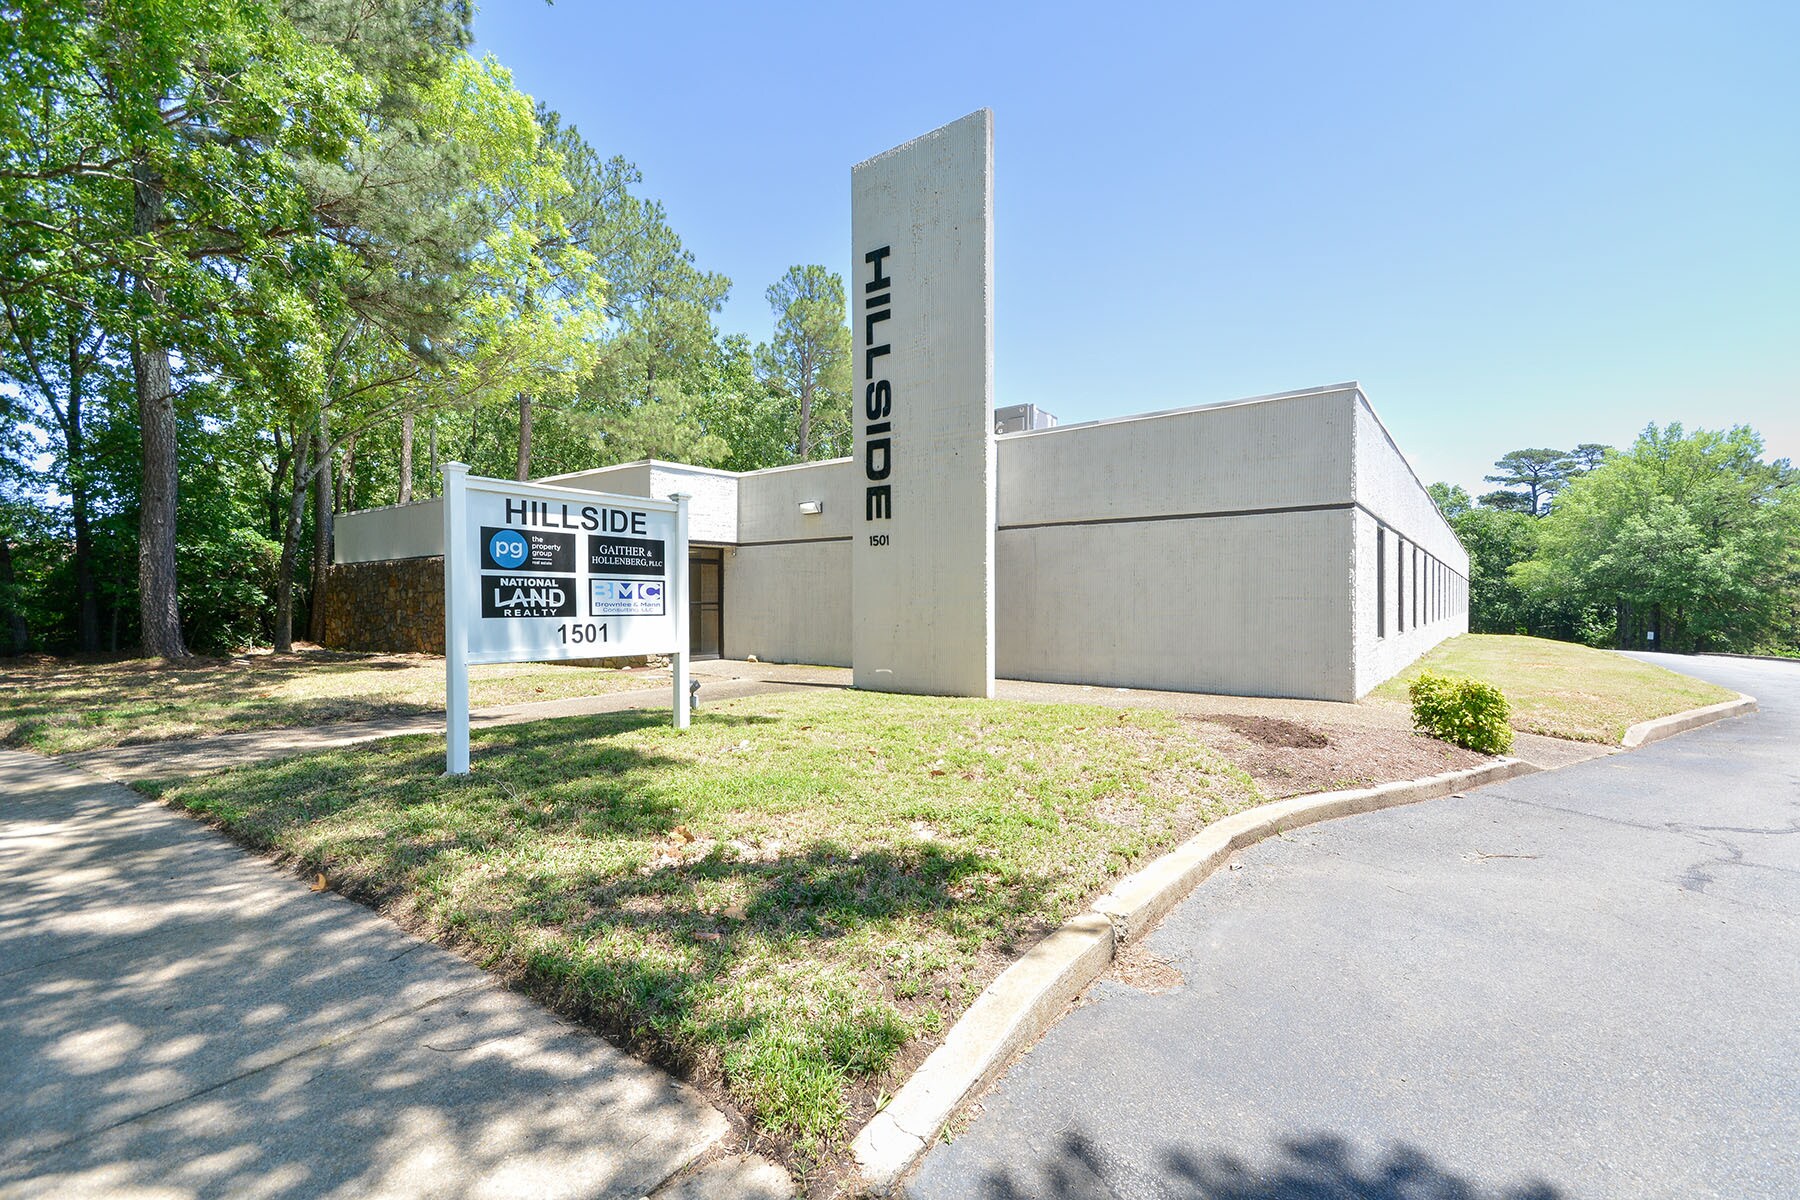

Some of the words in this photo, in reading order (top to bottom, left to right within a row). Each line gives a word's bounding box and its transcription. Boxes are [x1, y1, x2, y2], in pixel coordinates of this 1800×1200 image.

[865, 245, 892, 521] HILLSIDE
[505, 498, 647, 535] HILLSIDE
[531, 535, 544, 543] the
[869, 535, 890, 546] 1501
[495, 540, 523, 559] pg
[531, 543, 561, 552] property
[599, 544, 646, 557] GAITHER
[531, 550, 553, 558] group
[500, 577, 559, 587] NATIONAL
[494, 588, 566, 608] LAND
[503, 608, 557, 617] REALTY
[557, 623, 608, 644] 1501
